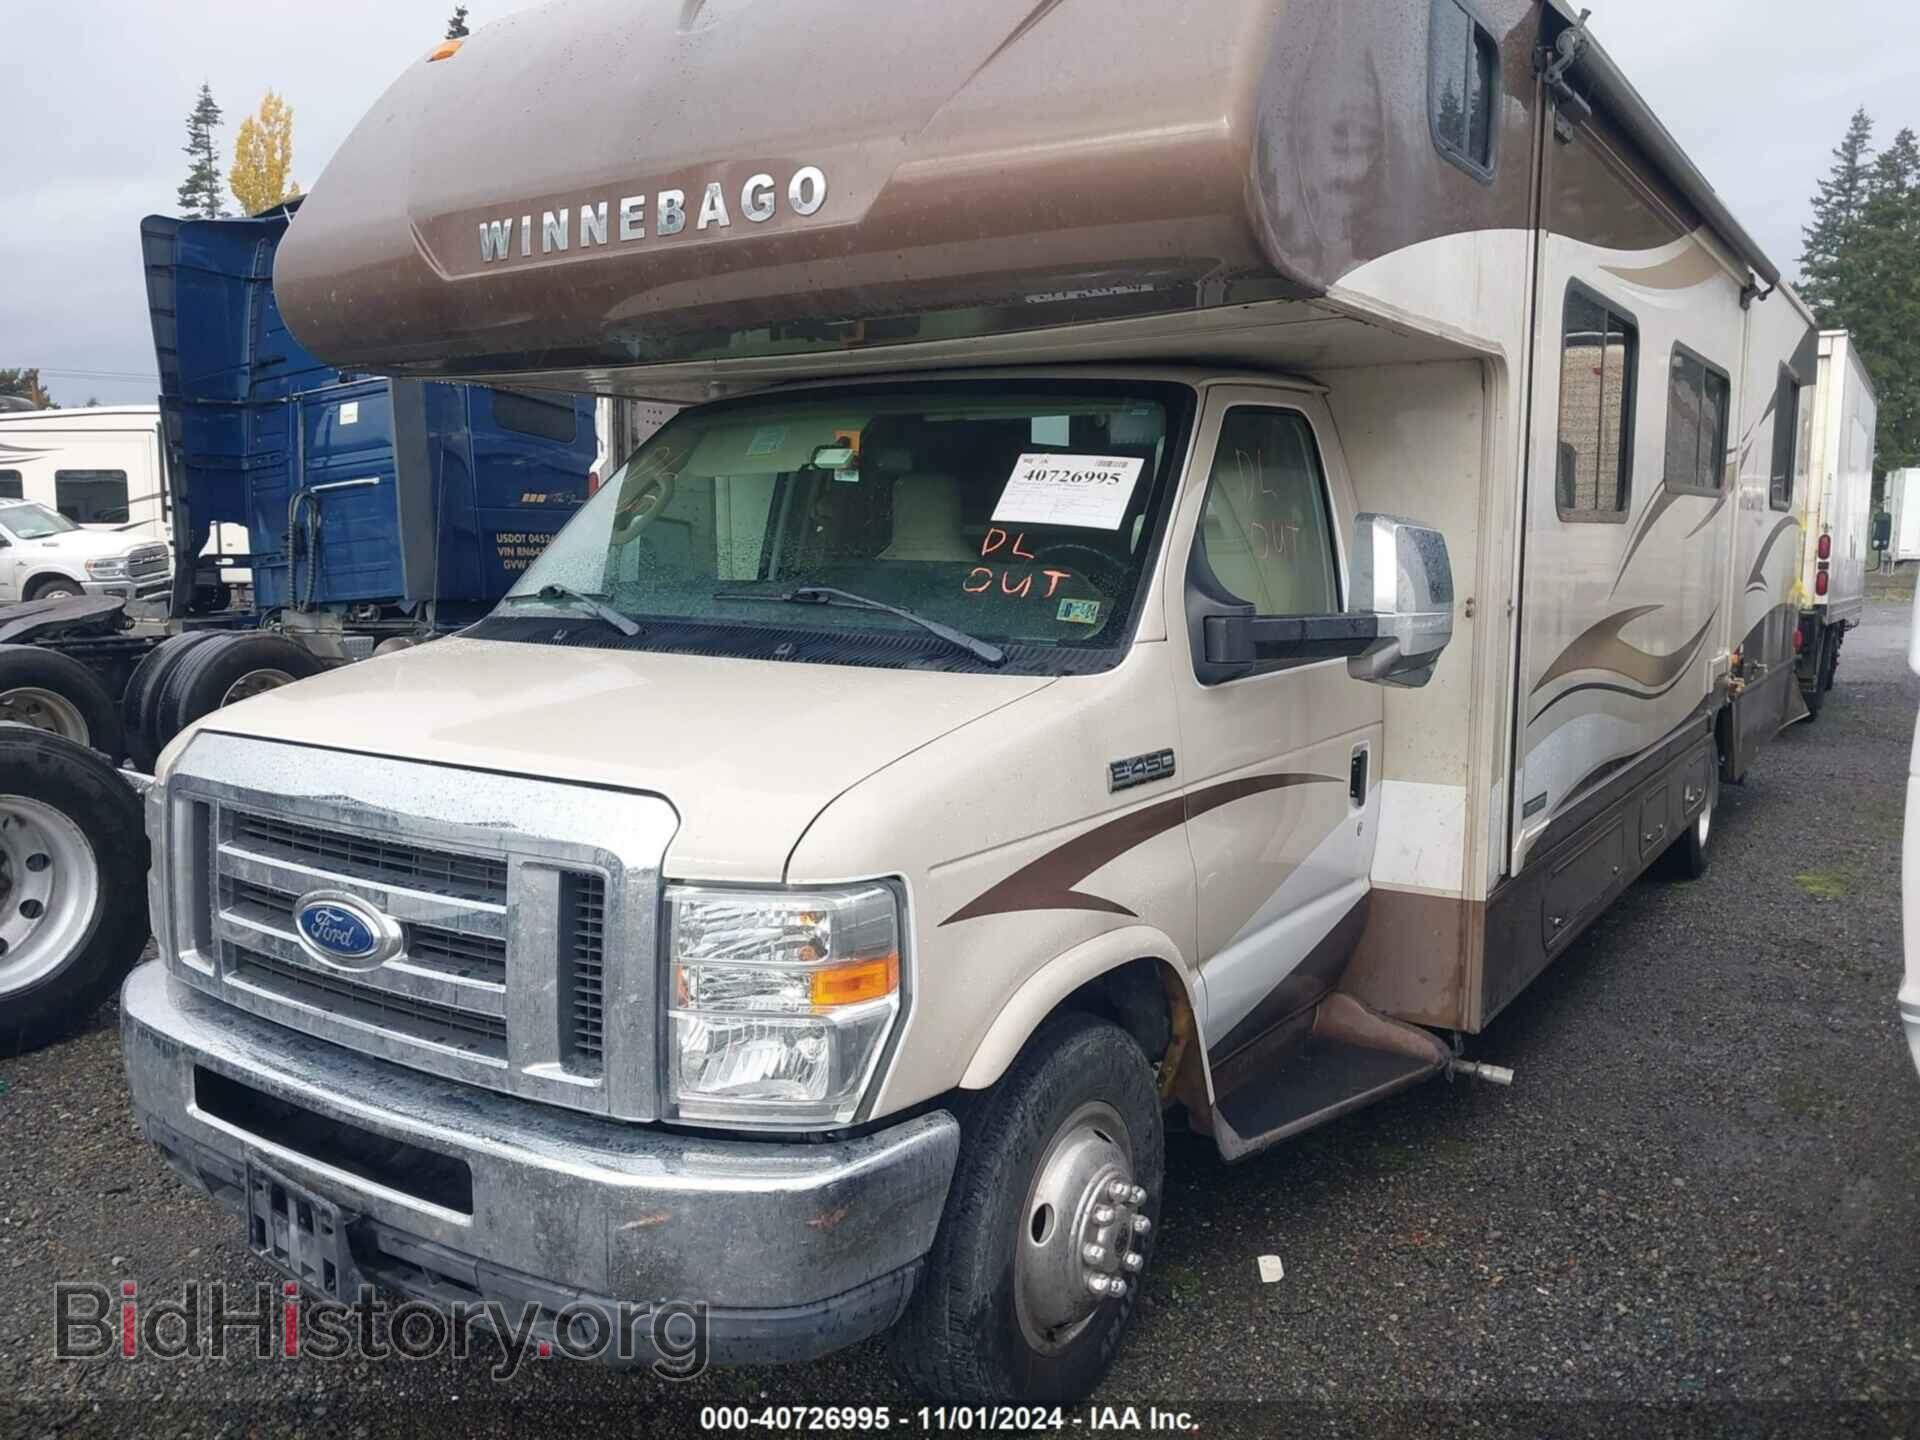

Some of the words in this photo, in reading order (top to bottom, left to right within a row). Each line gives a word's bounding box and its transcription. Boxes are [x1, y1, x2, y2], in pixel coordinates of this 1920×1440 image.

[478, 165, 827, 262] WINNEBAGO
[1023, 469, 1122, 486] 40726995
[496, 533, 526, 544] USDOT
[981, 528, 1035, 559] DL
[497, 546, 515, 557] VIN
[503, 559, 527, 570] GVW
[963, 567, 1071, 598] OUT
[311, 908, 355, 946] Ford
